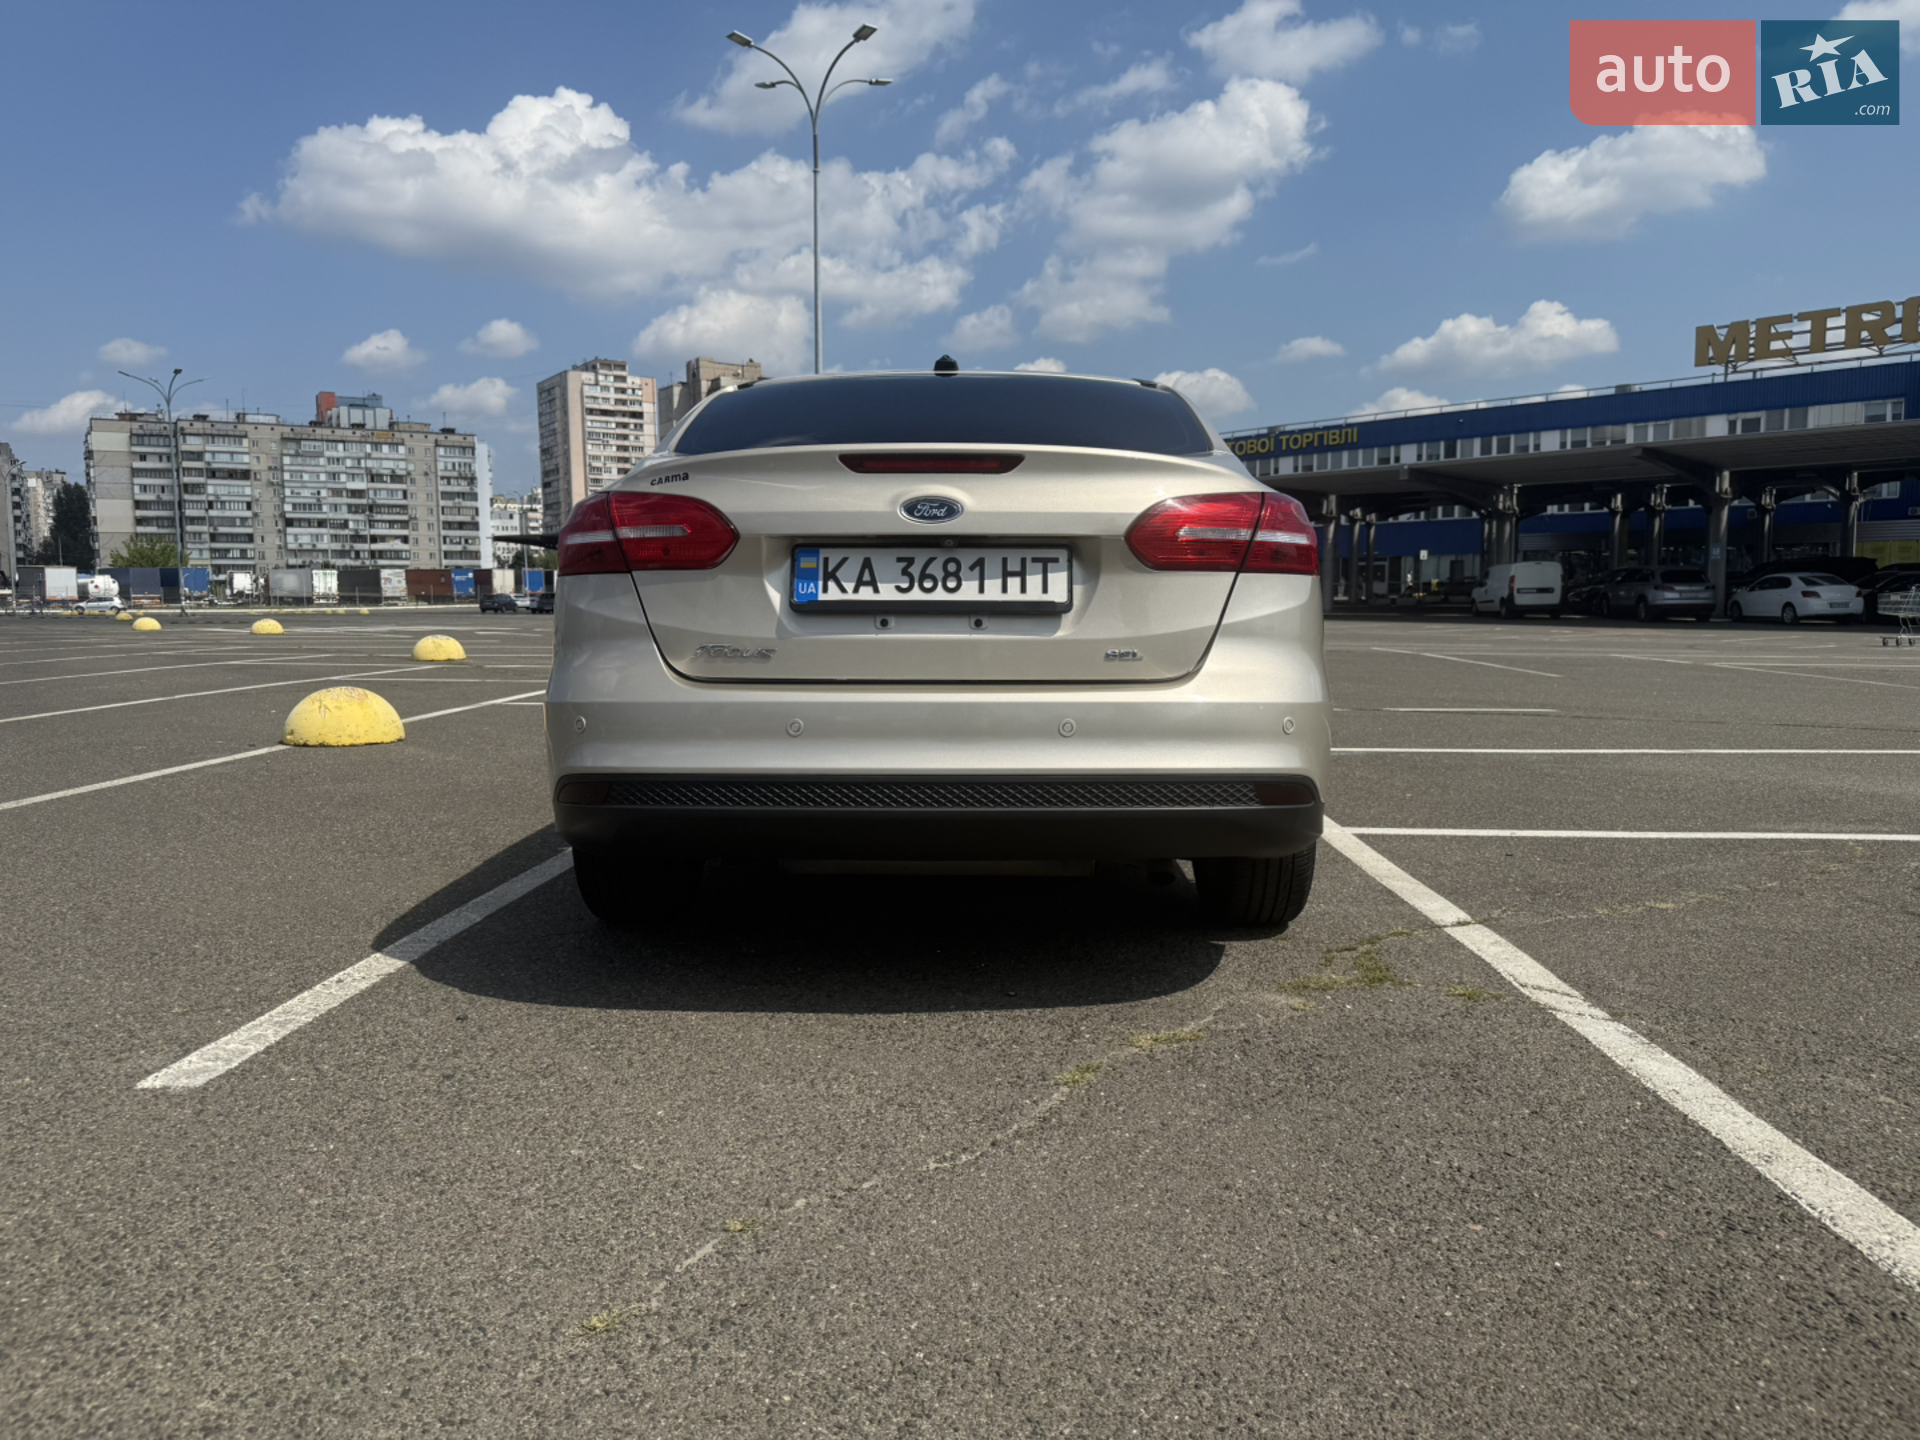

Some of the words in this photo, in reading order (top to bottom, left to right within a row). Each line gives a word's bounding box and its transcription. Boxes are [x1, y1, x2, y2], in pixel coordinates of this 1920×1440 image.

[1279, 427, 1359, 451] ТОРГІВЛІ
[914, 502, 948, 517] Ford
[822, 556, 881, 595] KA
[894, 556, 987, 595] 3681
[1001, 556, 1060, 595] HT
[798, 582, 817, 595] UA
